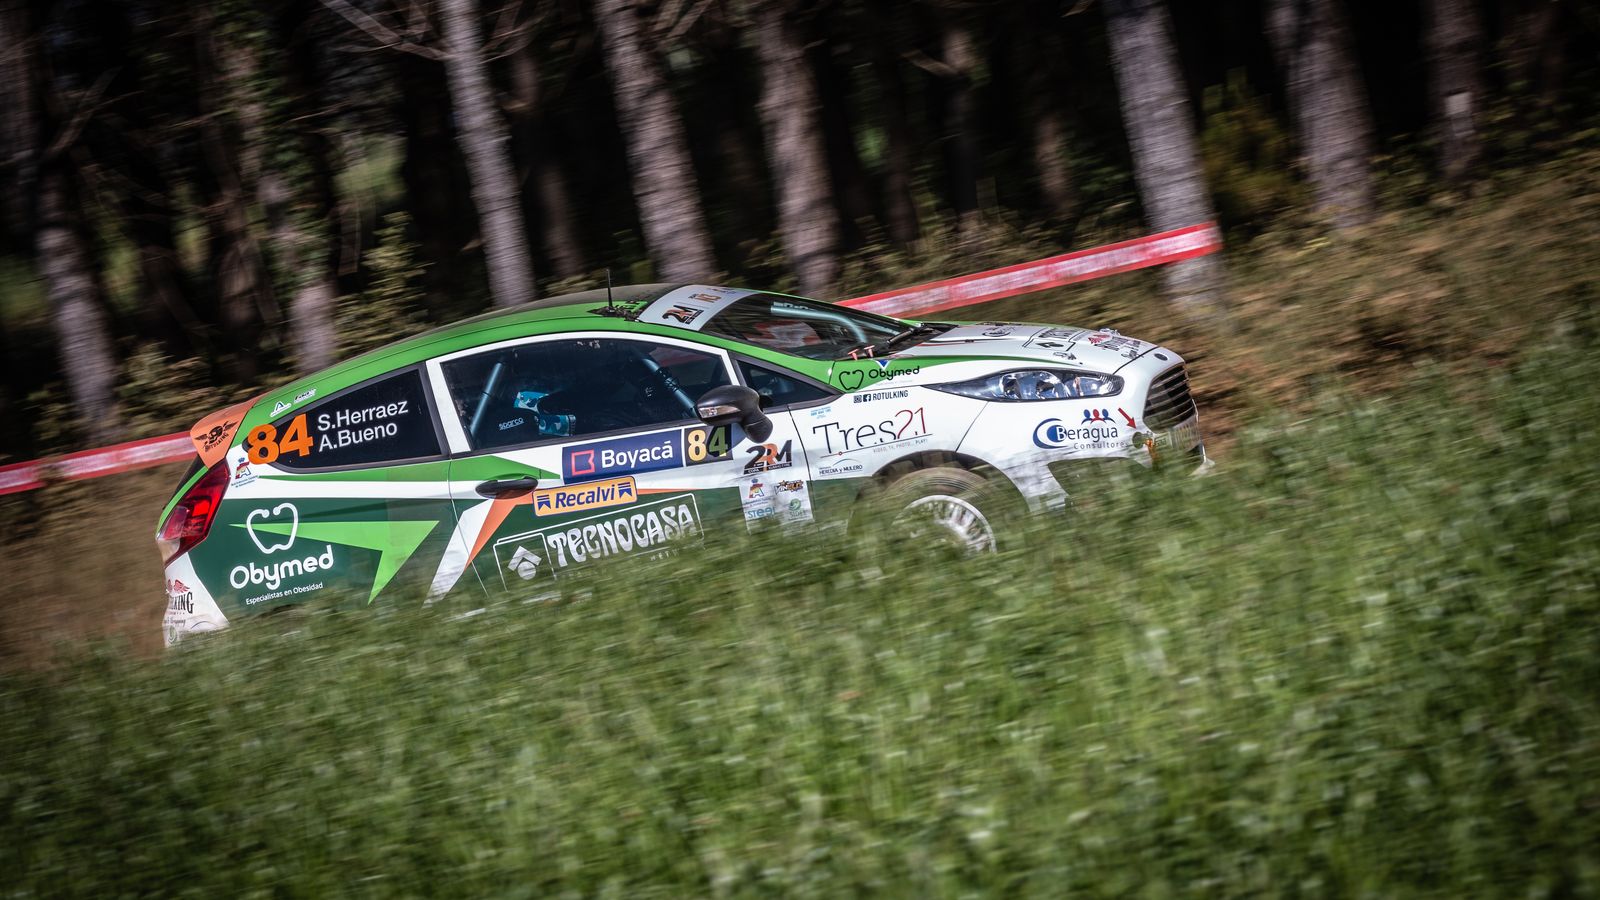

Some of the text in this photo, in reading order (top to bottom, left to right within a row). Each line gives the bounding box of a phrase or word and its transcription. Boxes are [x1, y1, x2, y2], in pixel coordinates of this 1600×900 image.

[868, 365, 920, 380] Obymed
[873, 390, 909, 401] ROTULKING
[317, 400, 408, 431] S.Herraez
[247, 413, 314, 465] 84
[318, 422, 398, 452] A.Bueno
[687, 425, 729, 462] 84
[601, 440, 674, 469] Boyacá
[555, 485, 615, 509] Recalvi
[547, 504, 698, 568] TECNOCASA
[229, 544, 334, 590] Obymed
[245, 582, 324, 605] Especialistas en Obesidad
